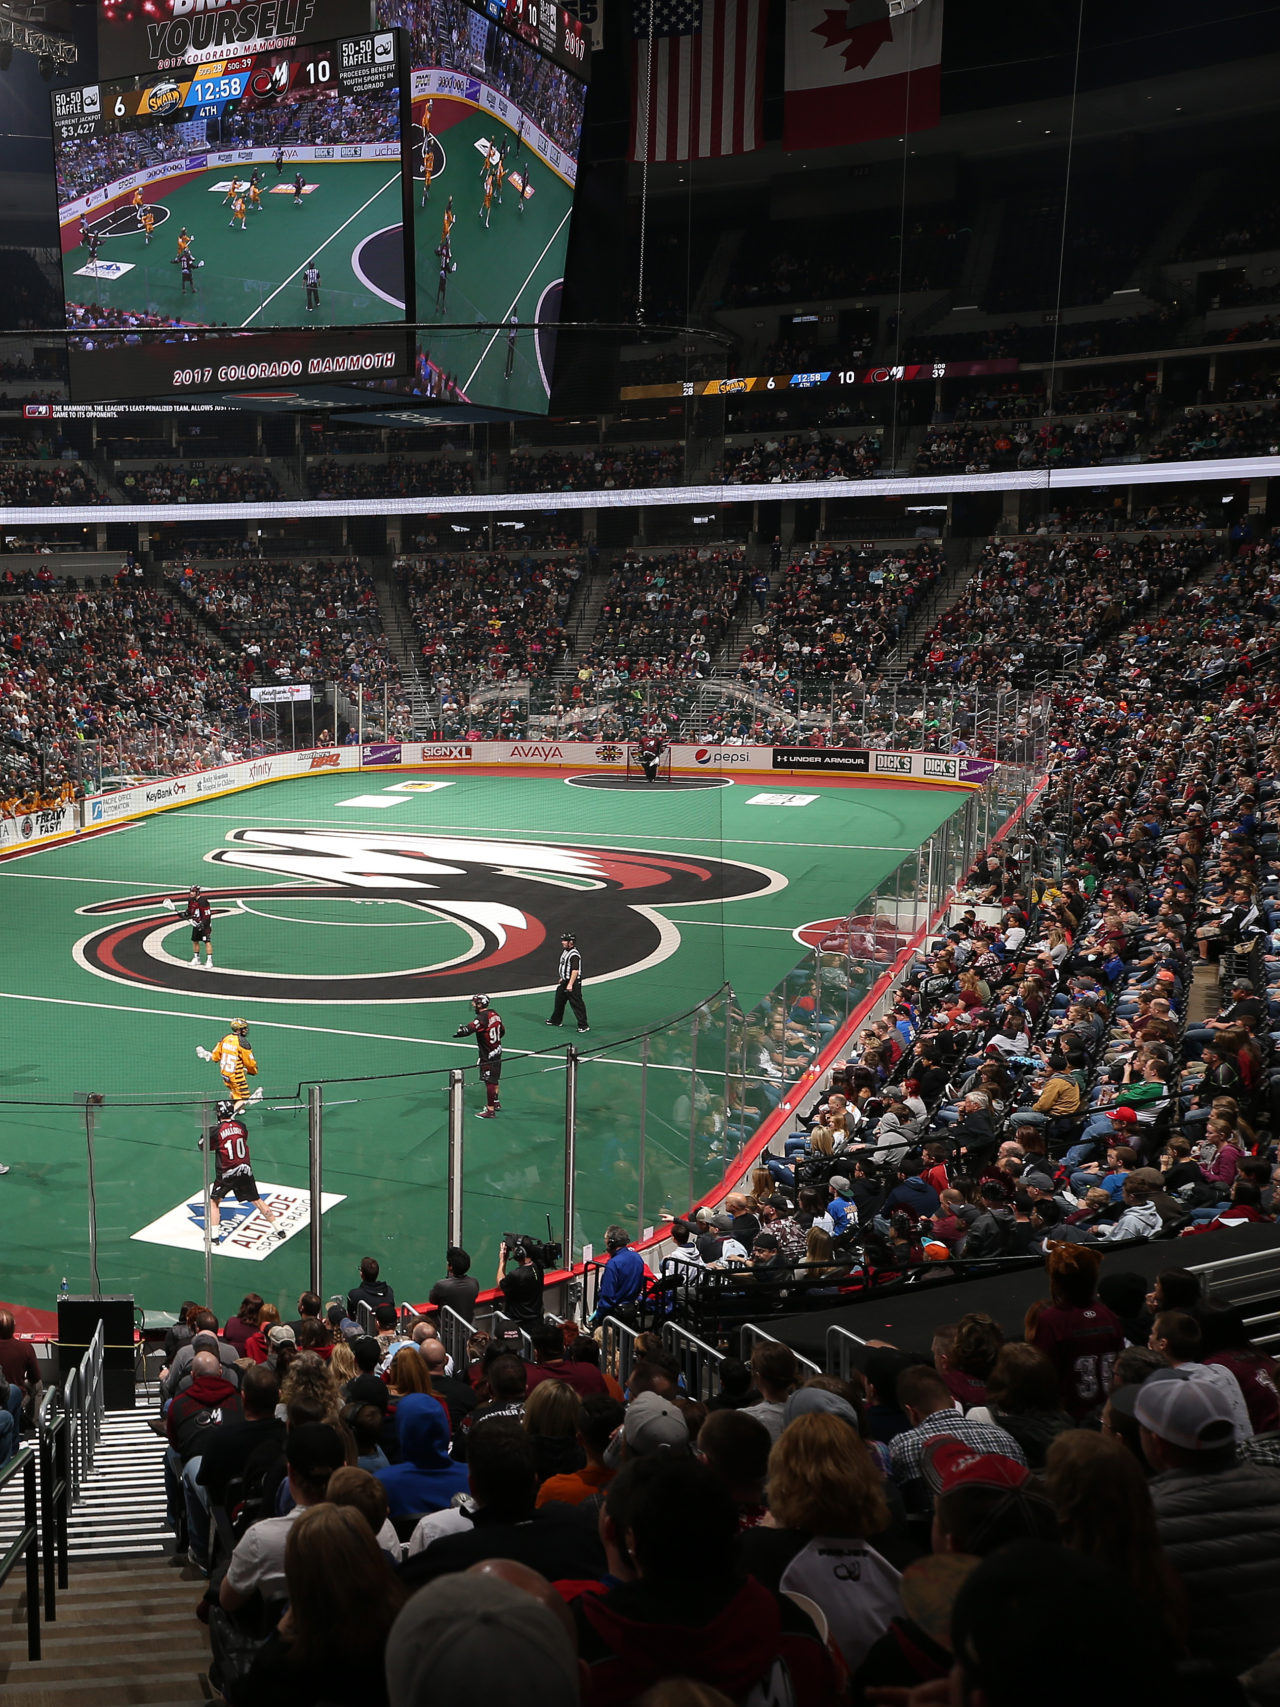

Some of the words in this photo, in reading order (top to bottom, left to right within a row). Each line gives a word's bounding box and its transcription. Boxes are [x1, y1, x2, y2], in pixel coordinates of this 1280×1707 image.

[528, 4, 537, 26] 10
[147, 0, 315, 59] YOURSELF
[158, 57, 183, 70] 2017
[187, 47, 239, 64] COLORADO
[243, 35, 296, 54] MAMMOTH
[343, 53, 372, 67] RAFFLE
[306, 60, 331, 84] 10
[339, 69, 370, 79] PROCEEDS
[370, 64, 396, 75] BENEFIT
[343, 77, 363, 87] YOUTH
[363, 74, 386, 84] SPORTS
[353, 81, 384, 92] COLORADO
[194, 78, 241, 102] 12:58
[114, 96, 125, 116] 6
[149, 89, 182, 111] SWARM
[56, 103, 82, 117] RAFFLE
[199, 105, 217, 118] 4TH
[55, 117, 78, 127] CURRENT
[78, 113, 101, 124] JACKPOT
[61, 123, 95, 138] $3,427
[172, 368, 212, 386] 2017
[217, 359, 303, 381] COLORADO
[308, 351, 396, 374] MAMMOTH
[932, 369, 945, 378] 39
[766, 377, 775, 389] 6
[797, 373, 821, 382] 12:58
[838, 371, 855, 384] 10
[683, 388, 694, 396] 28
[63, 404, 93, 412] MAMMOTH,
[129, 404, 172, 412] LEAST-PENALIZED
[174, 404, 190, 412] TEAM,
[297, 751, 331, 762] brothers
[423, 746, 450, 757] SIGN
[450, 746, 471, 759] XL
[510, 746, 563, 761] AVAYA
[713, 751, 750, 764] pepsi
[789, 755, 822, 764] UNDER
[309, 753, 341, 770] BBQ
[877, 755, 911, 770] DICK'S
[925, 759, 956, 773] DICK'S
[249, 760, 273, 780] xfinity
[103, 797, 118, 806] PACIFIC
[118, 793, 132, 803] OFFICE
[146, 787, 173, 803] KeyBank
[103, 801, 130, 814] AUTOMATION
[35, 808, 67, 825] FREAKY
[40, 821, 62, 835] FAST!
[224, 1137, 246, 1160] 10
[256, 1221, 294, 1251] SPOS
